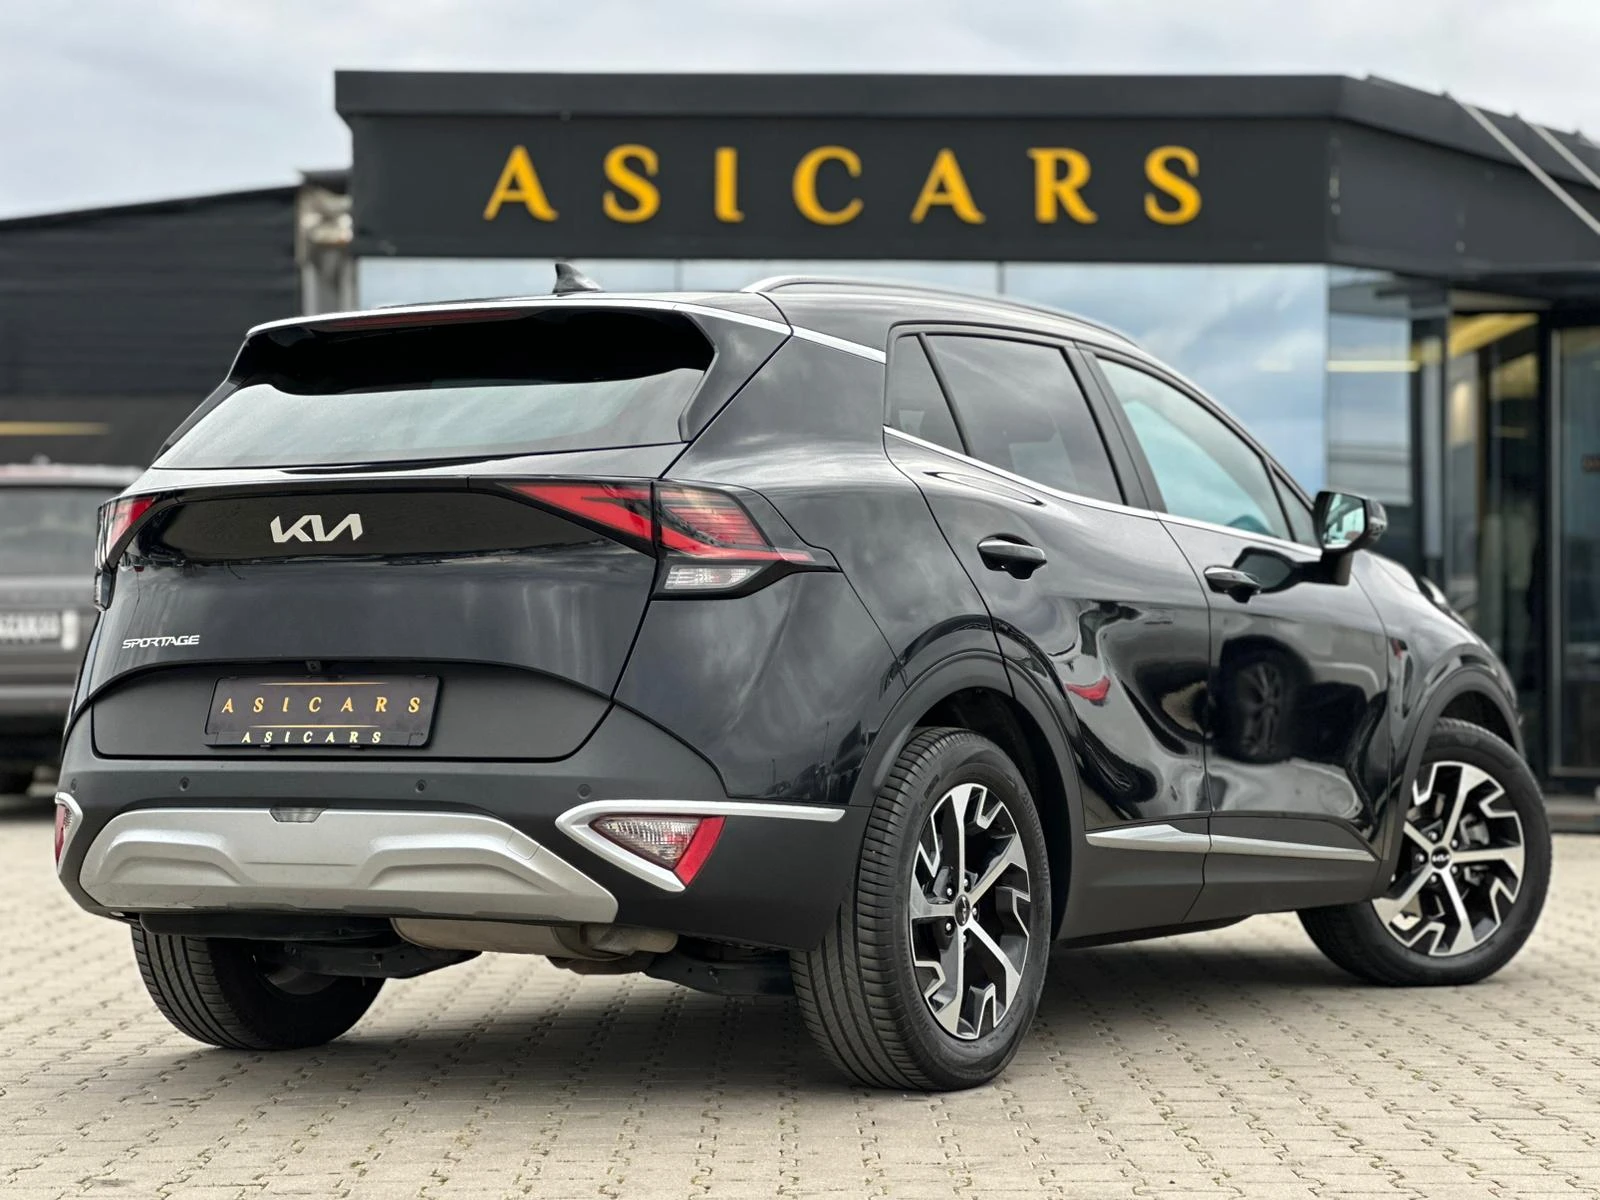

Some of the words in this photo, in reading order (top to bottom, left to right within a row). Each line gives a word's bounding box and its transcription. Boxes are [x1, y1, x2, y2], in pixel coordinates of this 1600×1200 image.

[483, 144, 1203, 225] ASICARS
[269, 513, 364, 543] KIA
[122, 634, 201, 649] SPORTAGE
[221, 696, 421, 714] ASICARS
[241, 731, 382, 744] ASICARS
